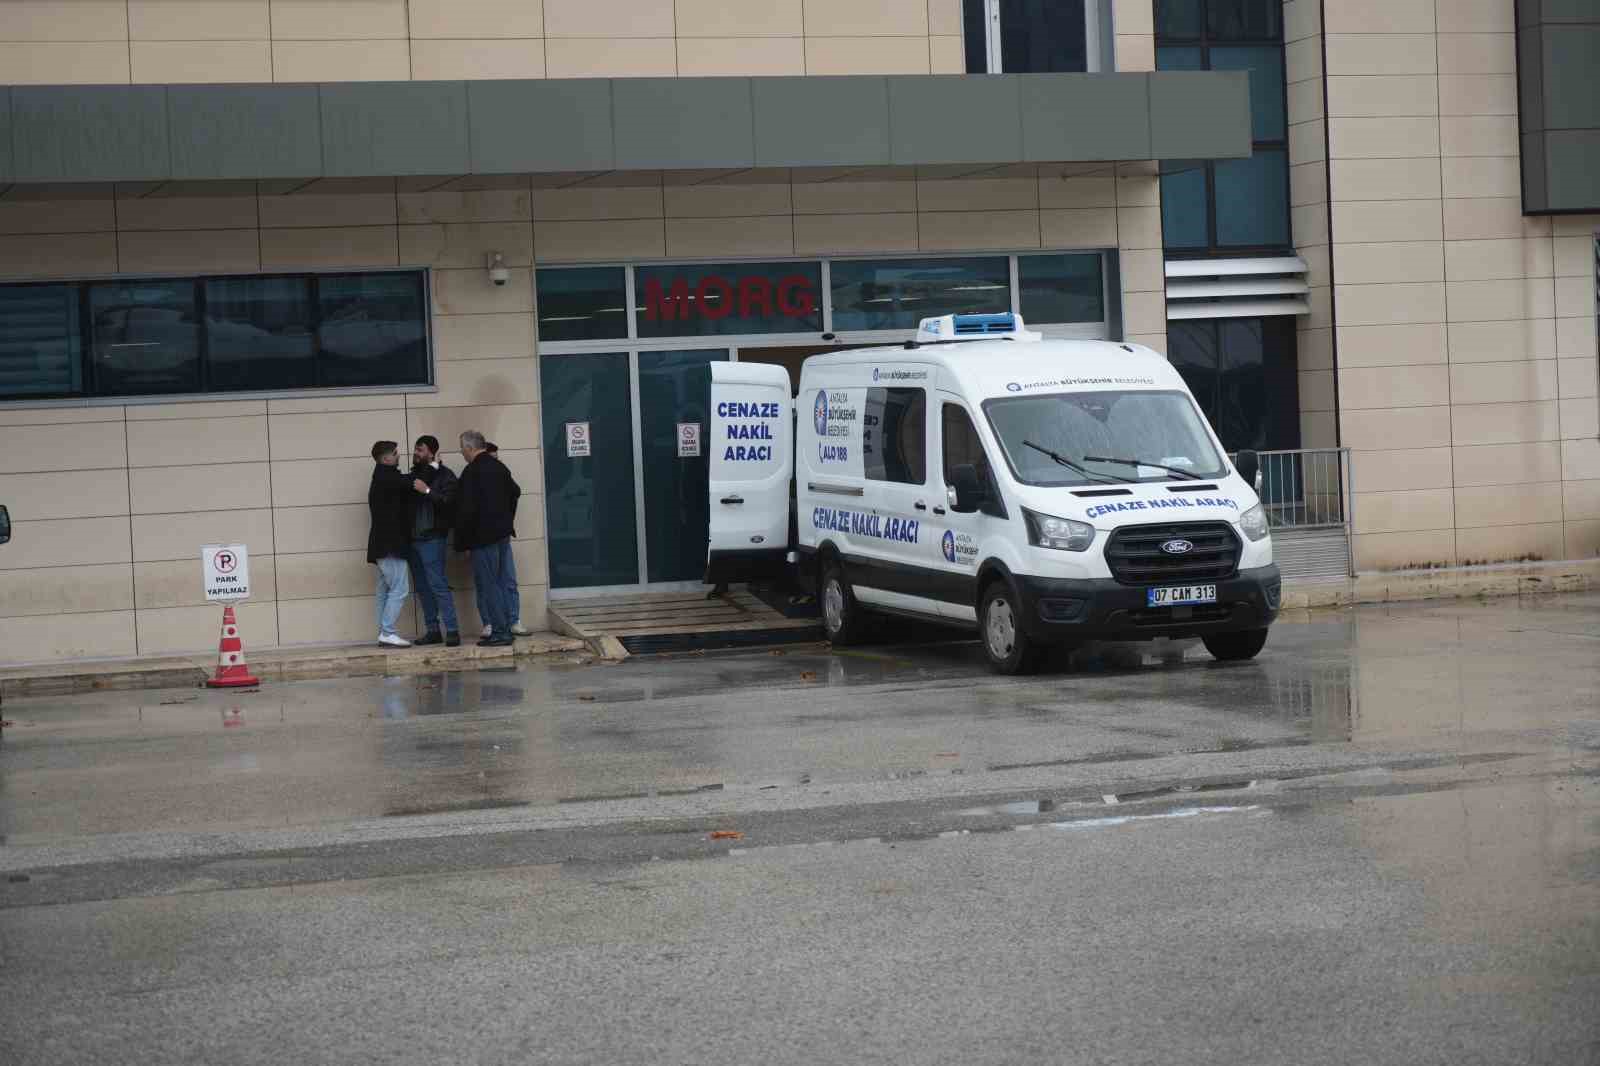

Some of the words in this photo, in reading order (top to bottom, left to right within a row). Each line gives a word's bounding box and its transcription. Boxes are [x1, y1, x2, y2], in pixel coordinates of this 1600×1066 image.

[644, 274, 816, 321] MORG
[718, 402, 779, 417] CENAZE
[727, 421, 773, 440] NAKİL
[724, 446, 772, 461] ARACI
[824, 446, 836, 460] ALO
[837, 447, 848, 461] 188
[1086, 500, 1147, 518] CENAZE
[1147, 497, 1195, 508] NAKİL
[1196, 498, 1239, 511] ARACI
[813, 507, 850, 532] CENAZE
[851, 509, 882, 538] NAKİL
[883, 517, 920, 543] ARACI
[207, 586, 248, 596] YAPILMAZ
[1154, 587, 1167, 601] 07
[1171, 586, 1192, 600] CAM
[1195, 585, 1216, 599] 313
